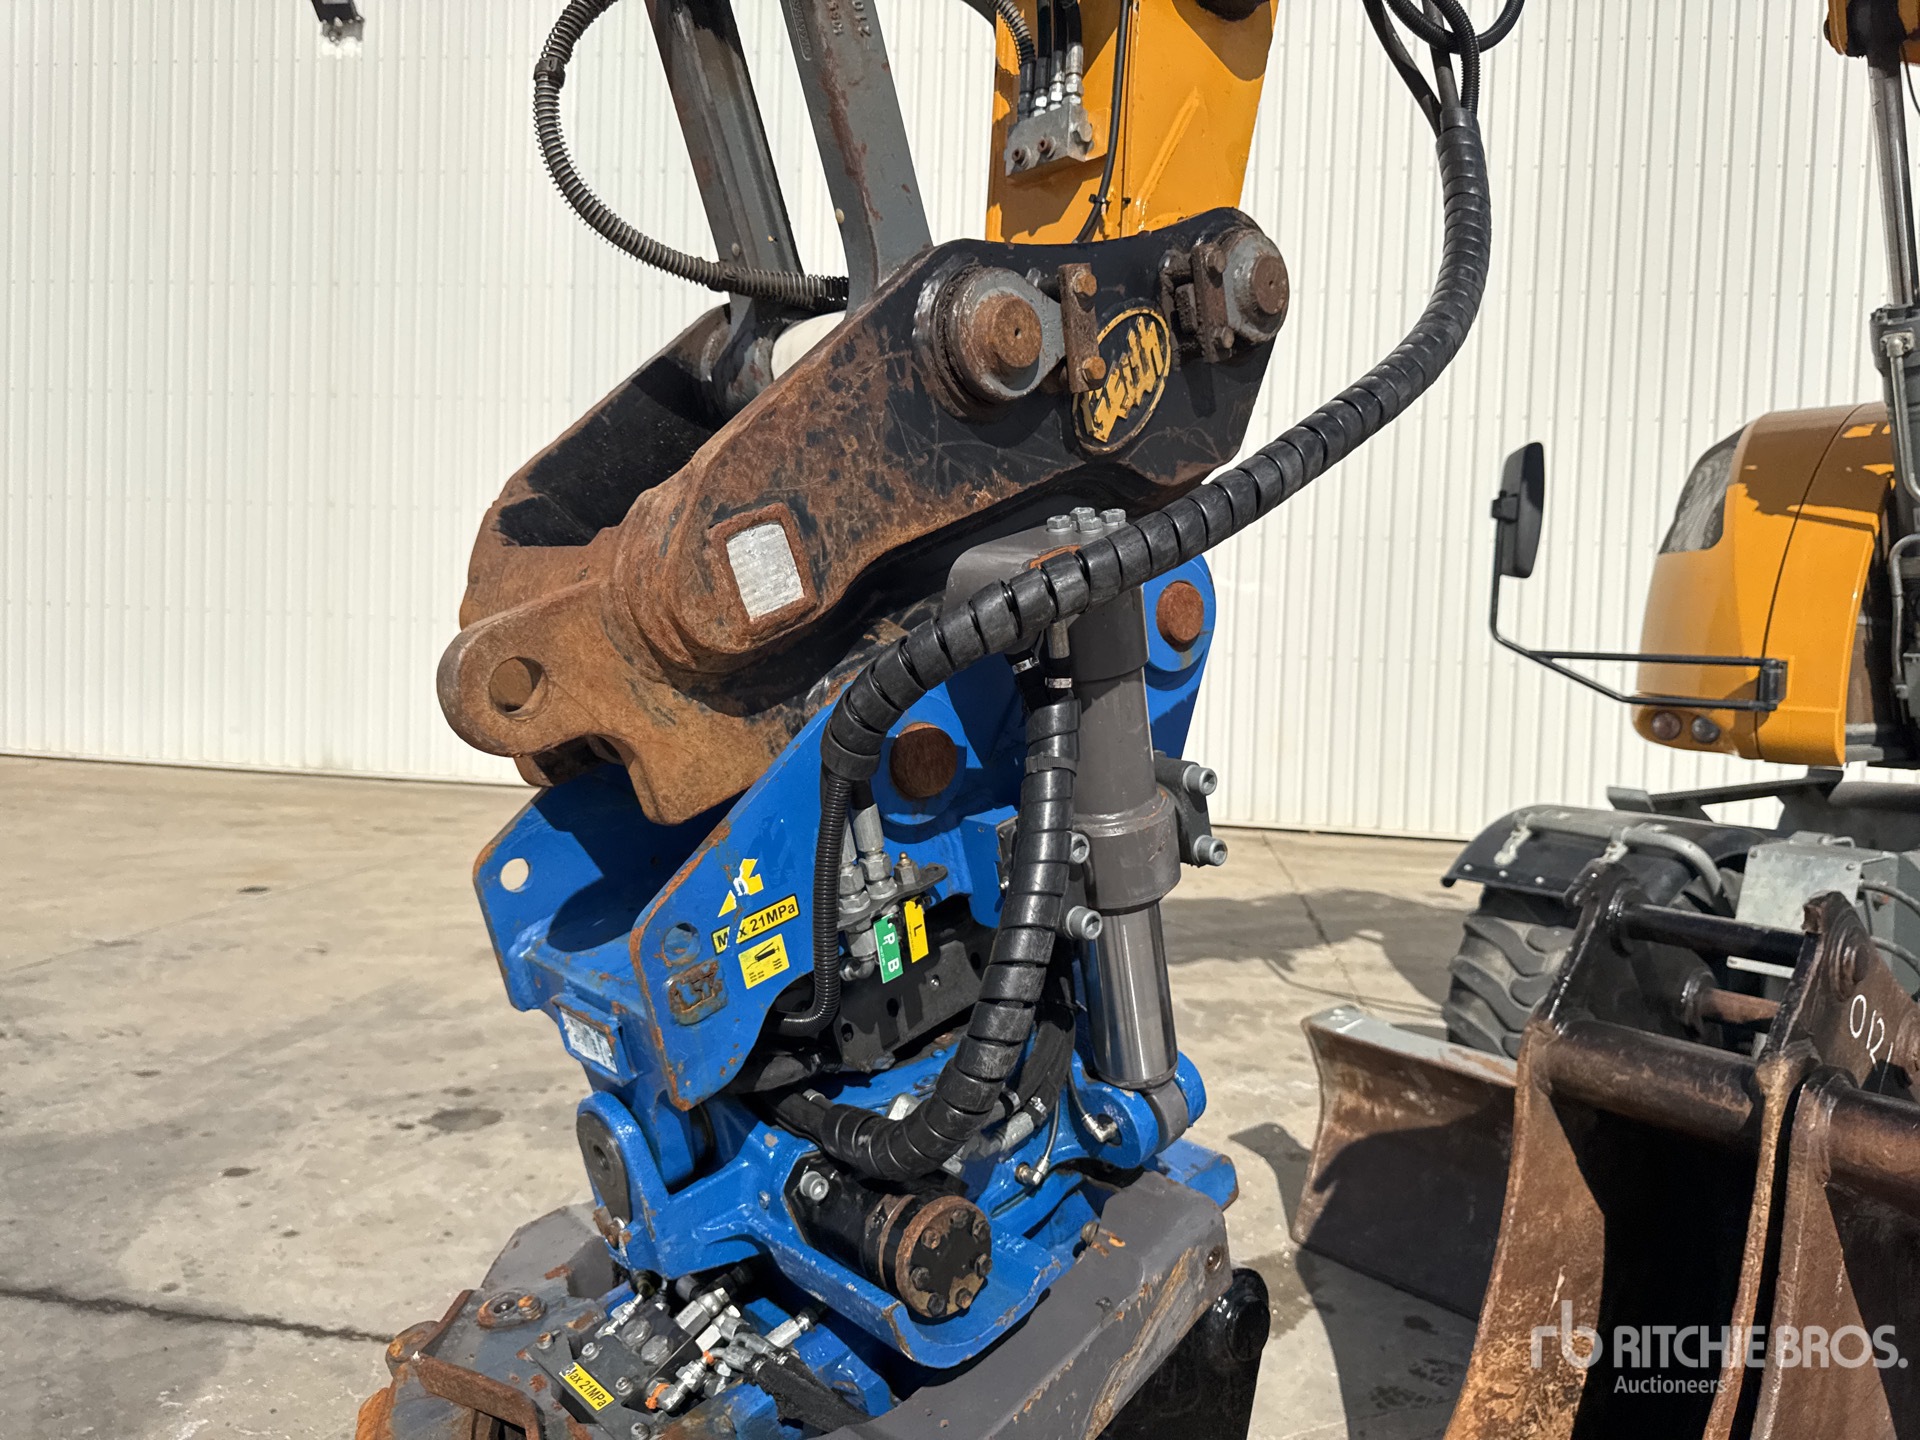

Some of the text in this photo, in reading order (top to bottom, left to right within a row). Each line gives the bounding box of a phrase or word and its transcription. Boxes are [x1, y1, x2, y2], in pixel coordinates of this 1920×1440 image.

[750, 903, 796, 931] 21MPa
[914, 924, 923, 937] L
[887, 957, 900, 973] B
[578, 1380, 607, 1407] 21MPa
